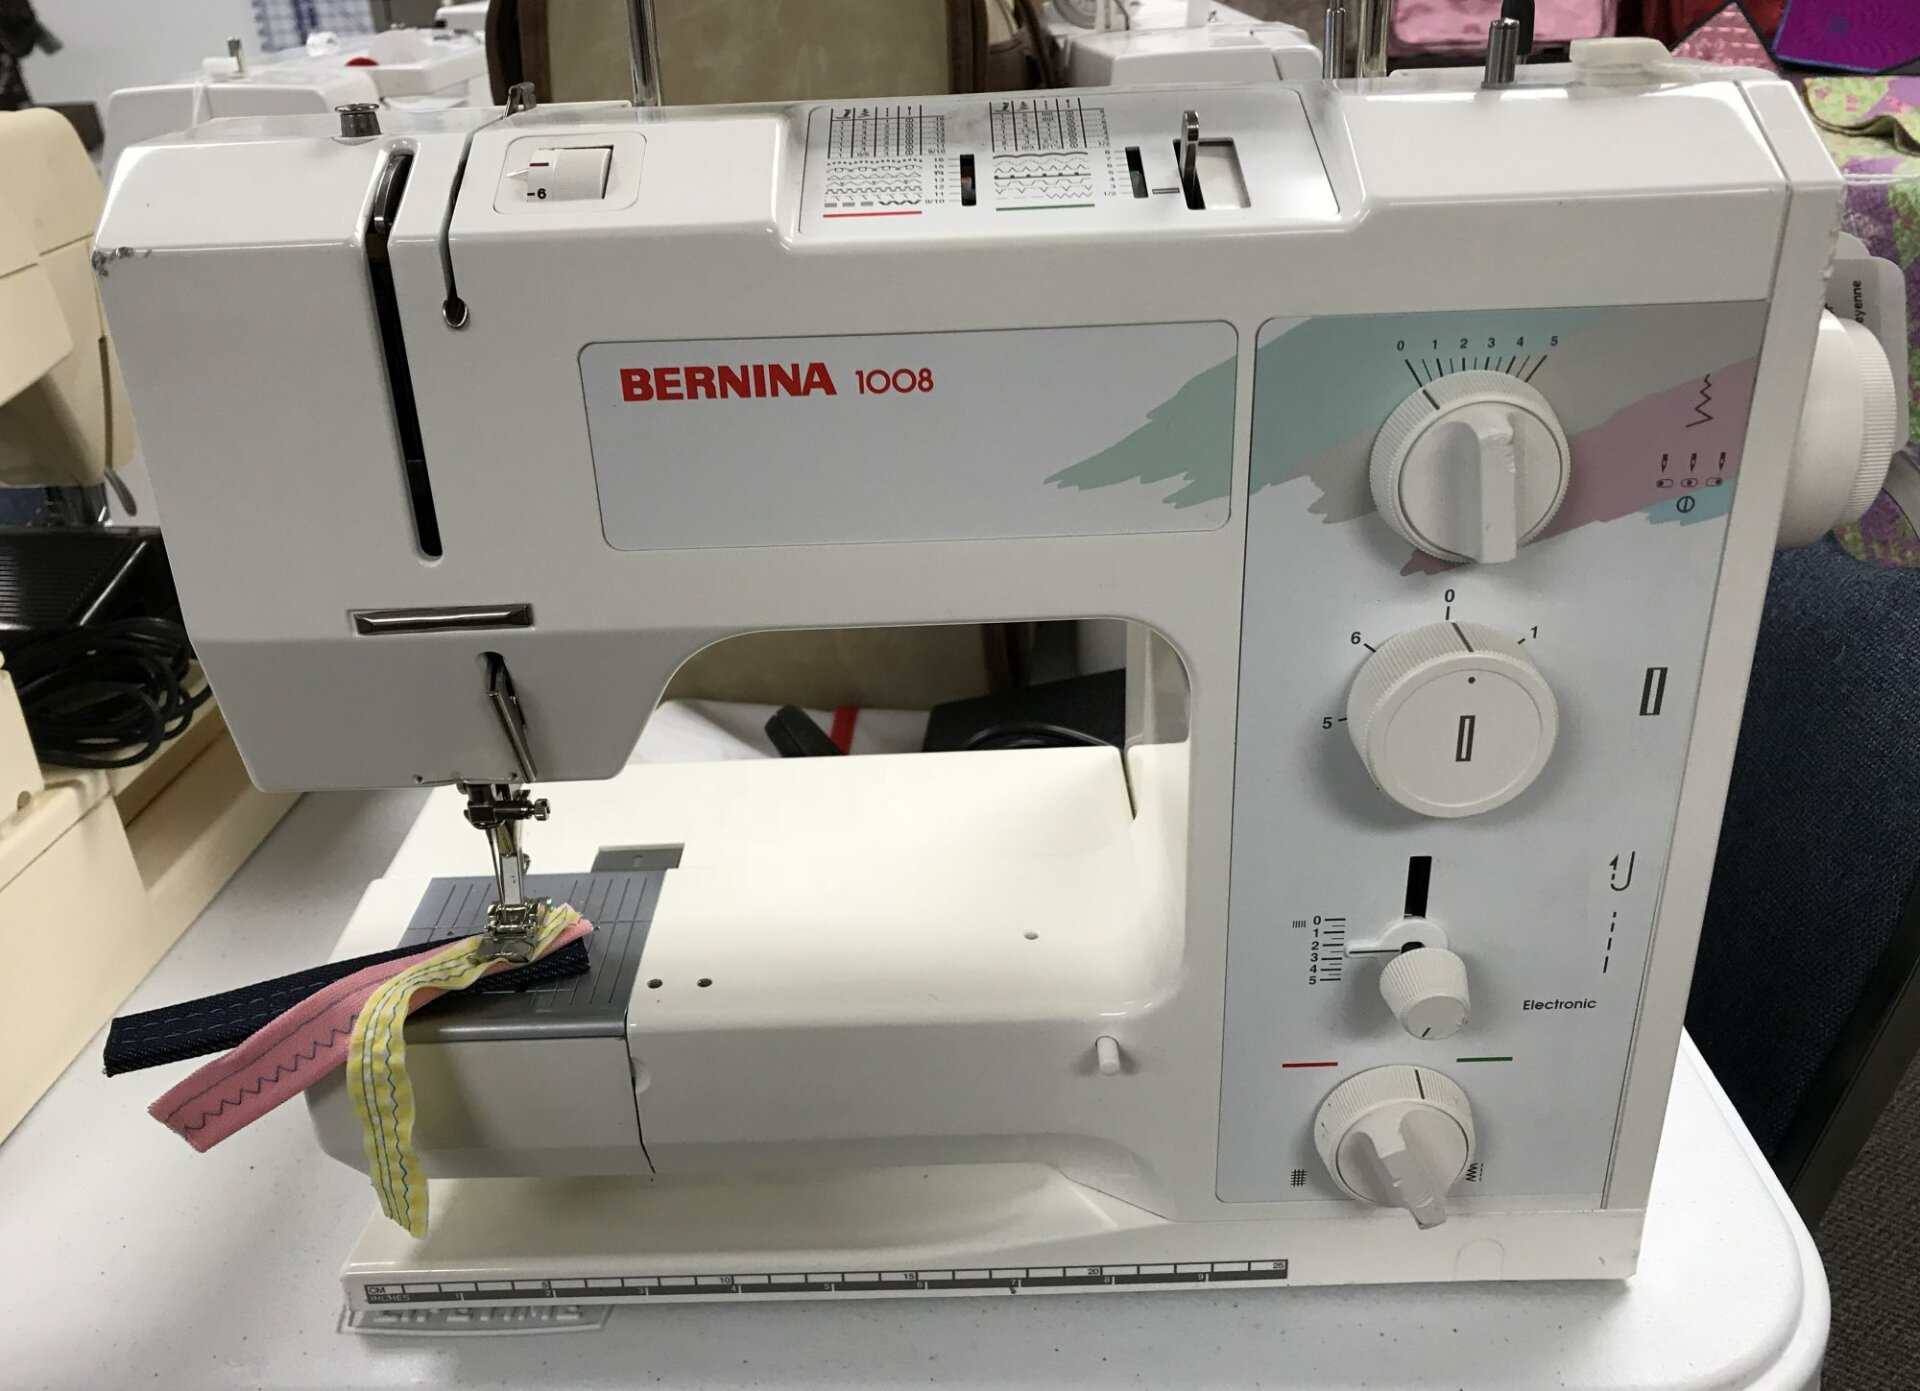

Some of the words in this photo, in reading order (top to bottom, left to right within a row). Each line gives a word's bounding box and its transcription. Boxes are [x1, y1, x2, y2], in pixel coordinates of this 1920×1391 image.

[1396, 340, 1405, 351] 0
[1432, 339, 1438, 350] 1
[1460, 338, 1468, 349] 2
[1487, 337, 1496, 348] 3
[1516, 336, 1524, 347] 4
[1550, 336, 1558, 346] 5
[620, 362, 837, 402] BERNINA
[855, 368, 934, 394] 1008
[1444, 588, 1455, 602] 0
[1350, 631, 1362, 644] 6
[1530, 626, 1538, 639] 1
[1322, 717, 1333, 730] 5
[1313, 915, 1321, 925] 0
[1313, 928, 1318, 937] 1
[1311, 941, 1319, 950] 2
[1310, 952, 1318, 962] 3
[1309, 964, 1317, 974] 4
[1308, 976, 1316, 985] 5
[1523, 998, 1597, 1010] Electronic
